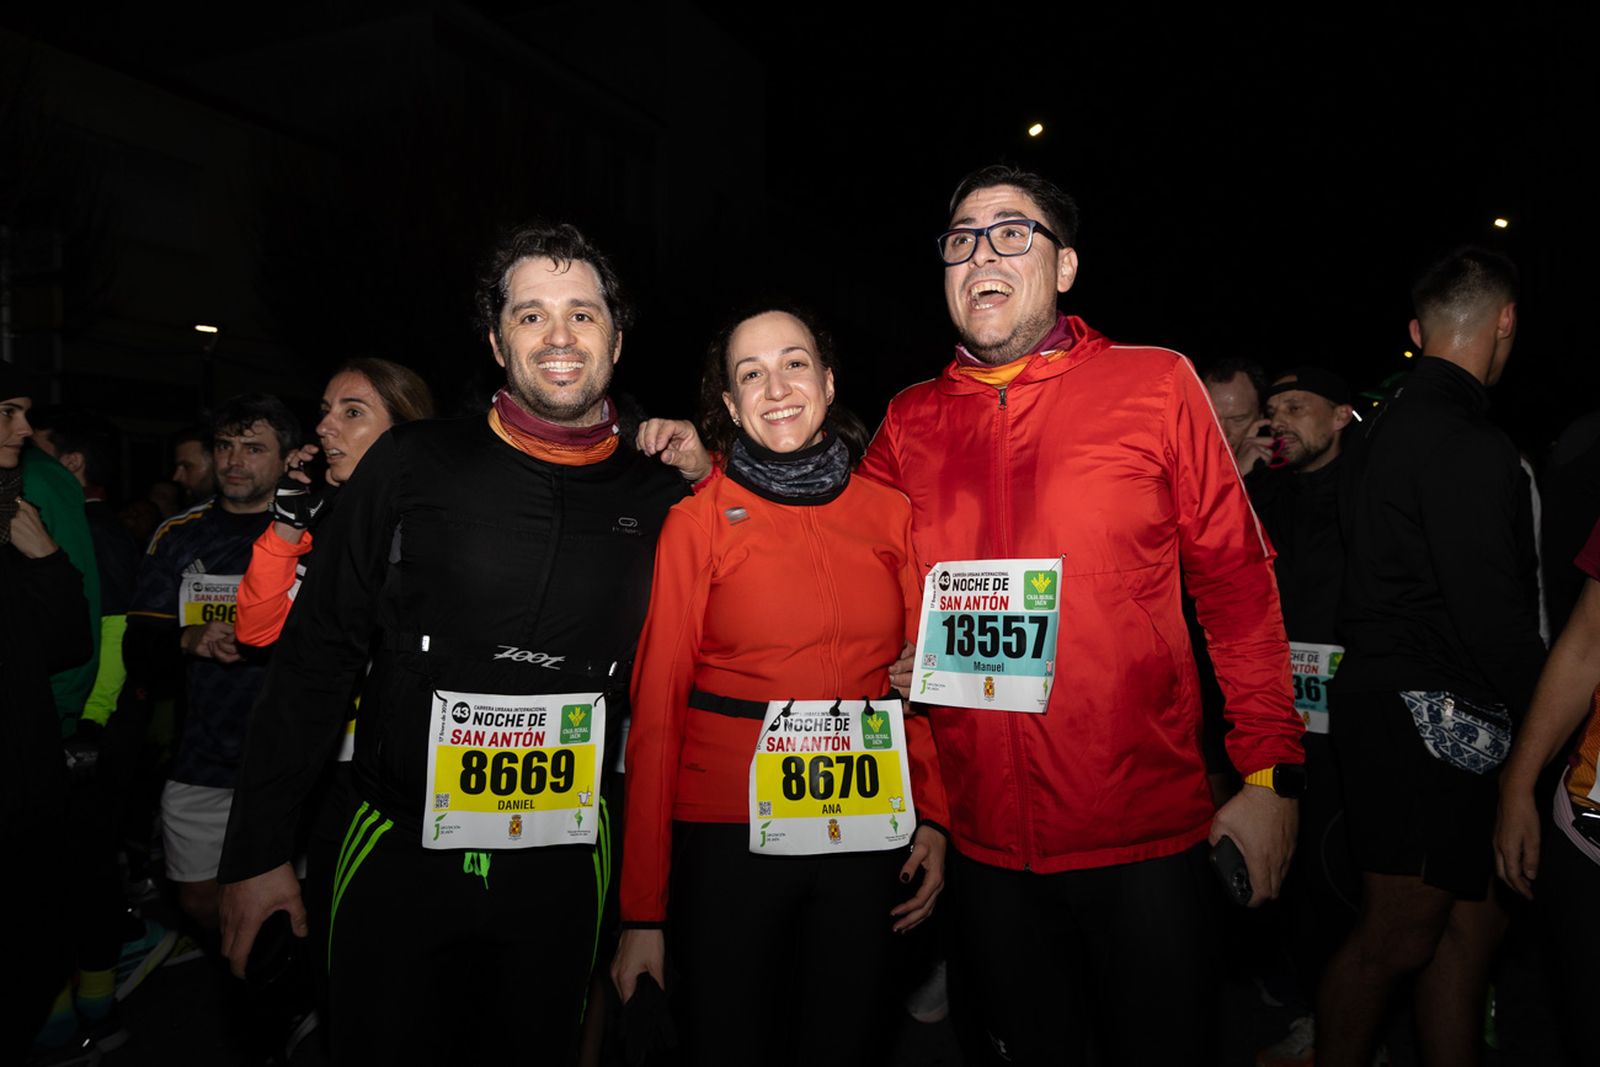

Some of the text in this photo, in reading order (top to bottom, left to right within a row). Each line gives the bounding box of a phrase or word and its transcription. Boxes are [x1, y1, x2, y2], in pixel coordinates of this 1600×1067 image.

[952, 578, 1009, 591] NOCHE DE
[940, 593, 1009, 610] SAN ANTÓN
[943, 614, 1049, 659] 13557
[1307, 654, 1320, 662] DE
[973, 661, 1004, 672] Manuel
[453, 706, 470, 718] 43
[473, 712, 547, 727] NOCHE DE
[784, 718, 849, 732] NOCHE DE
[450, 727, 545, 747] SAN ANTÓN
[766, 736, 796, 752] SAN
[800, 732, 850, 751] ANTÓN
[460, 749, 575, 796] 8669
[782, 754, 879, 801] 8670
[498, 800, 535, 810] DANIEL
[822, 804, 842, 814] ANA
